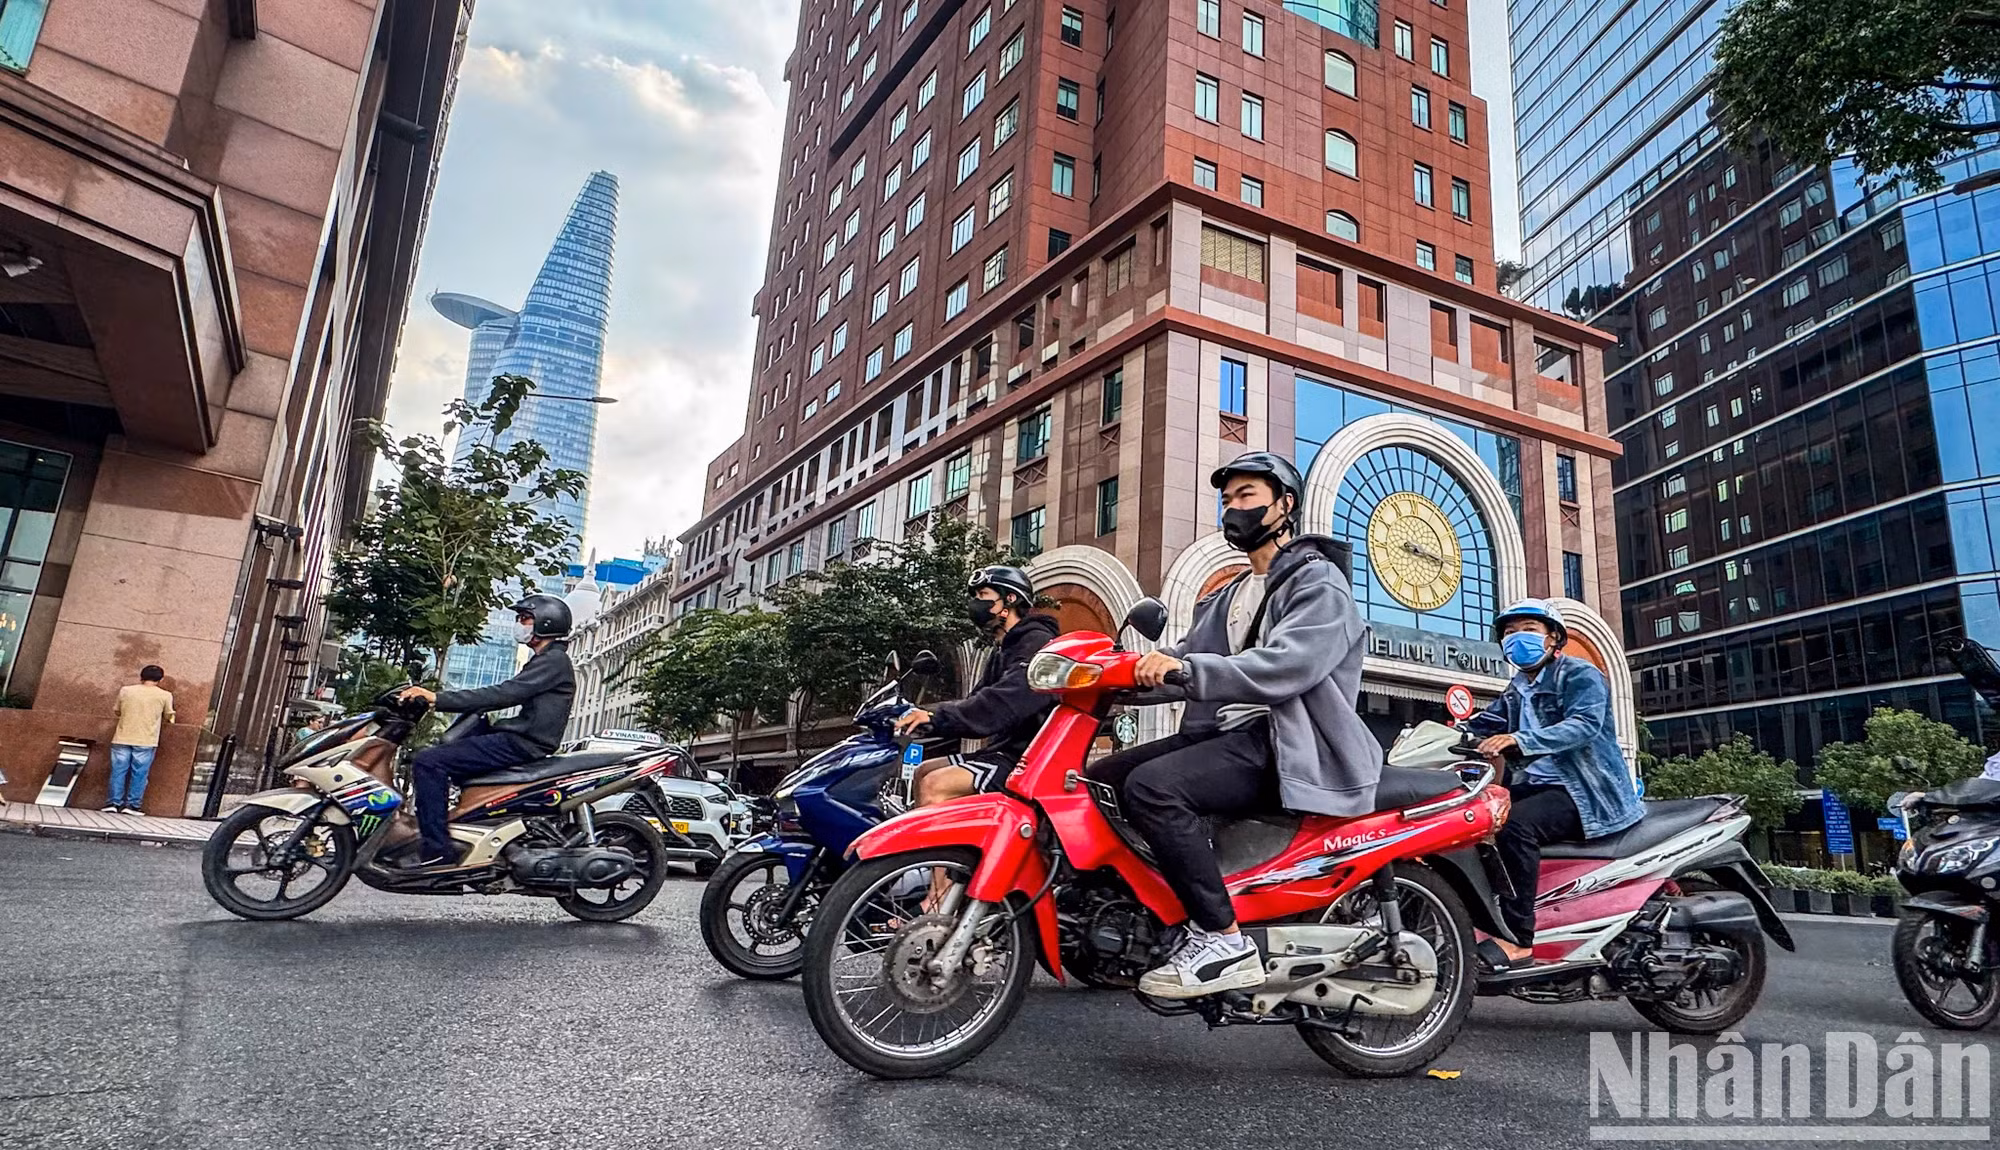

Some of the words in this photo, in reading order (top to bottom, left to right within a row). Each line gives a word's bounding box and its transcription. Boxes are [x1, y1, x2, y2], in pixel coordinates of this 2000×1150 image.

[1444, 643, 1502, 674] POINT
[615, 731, 646, 740] VINASUN
[910, 749, 920, 760] P
